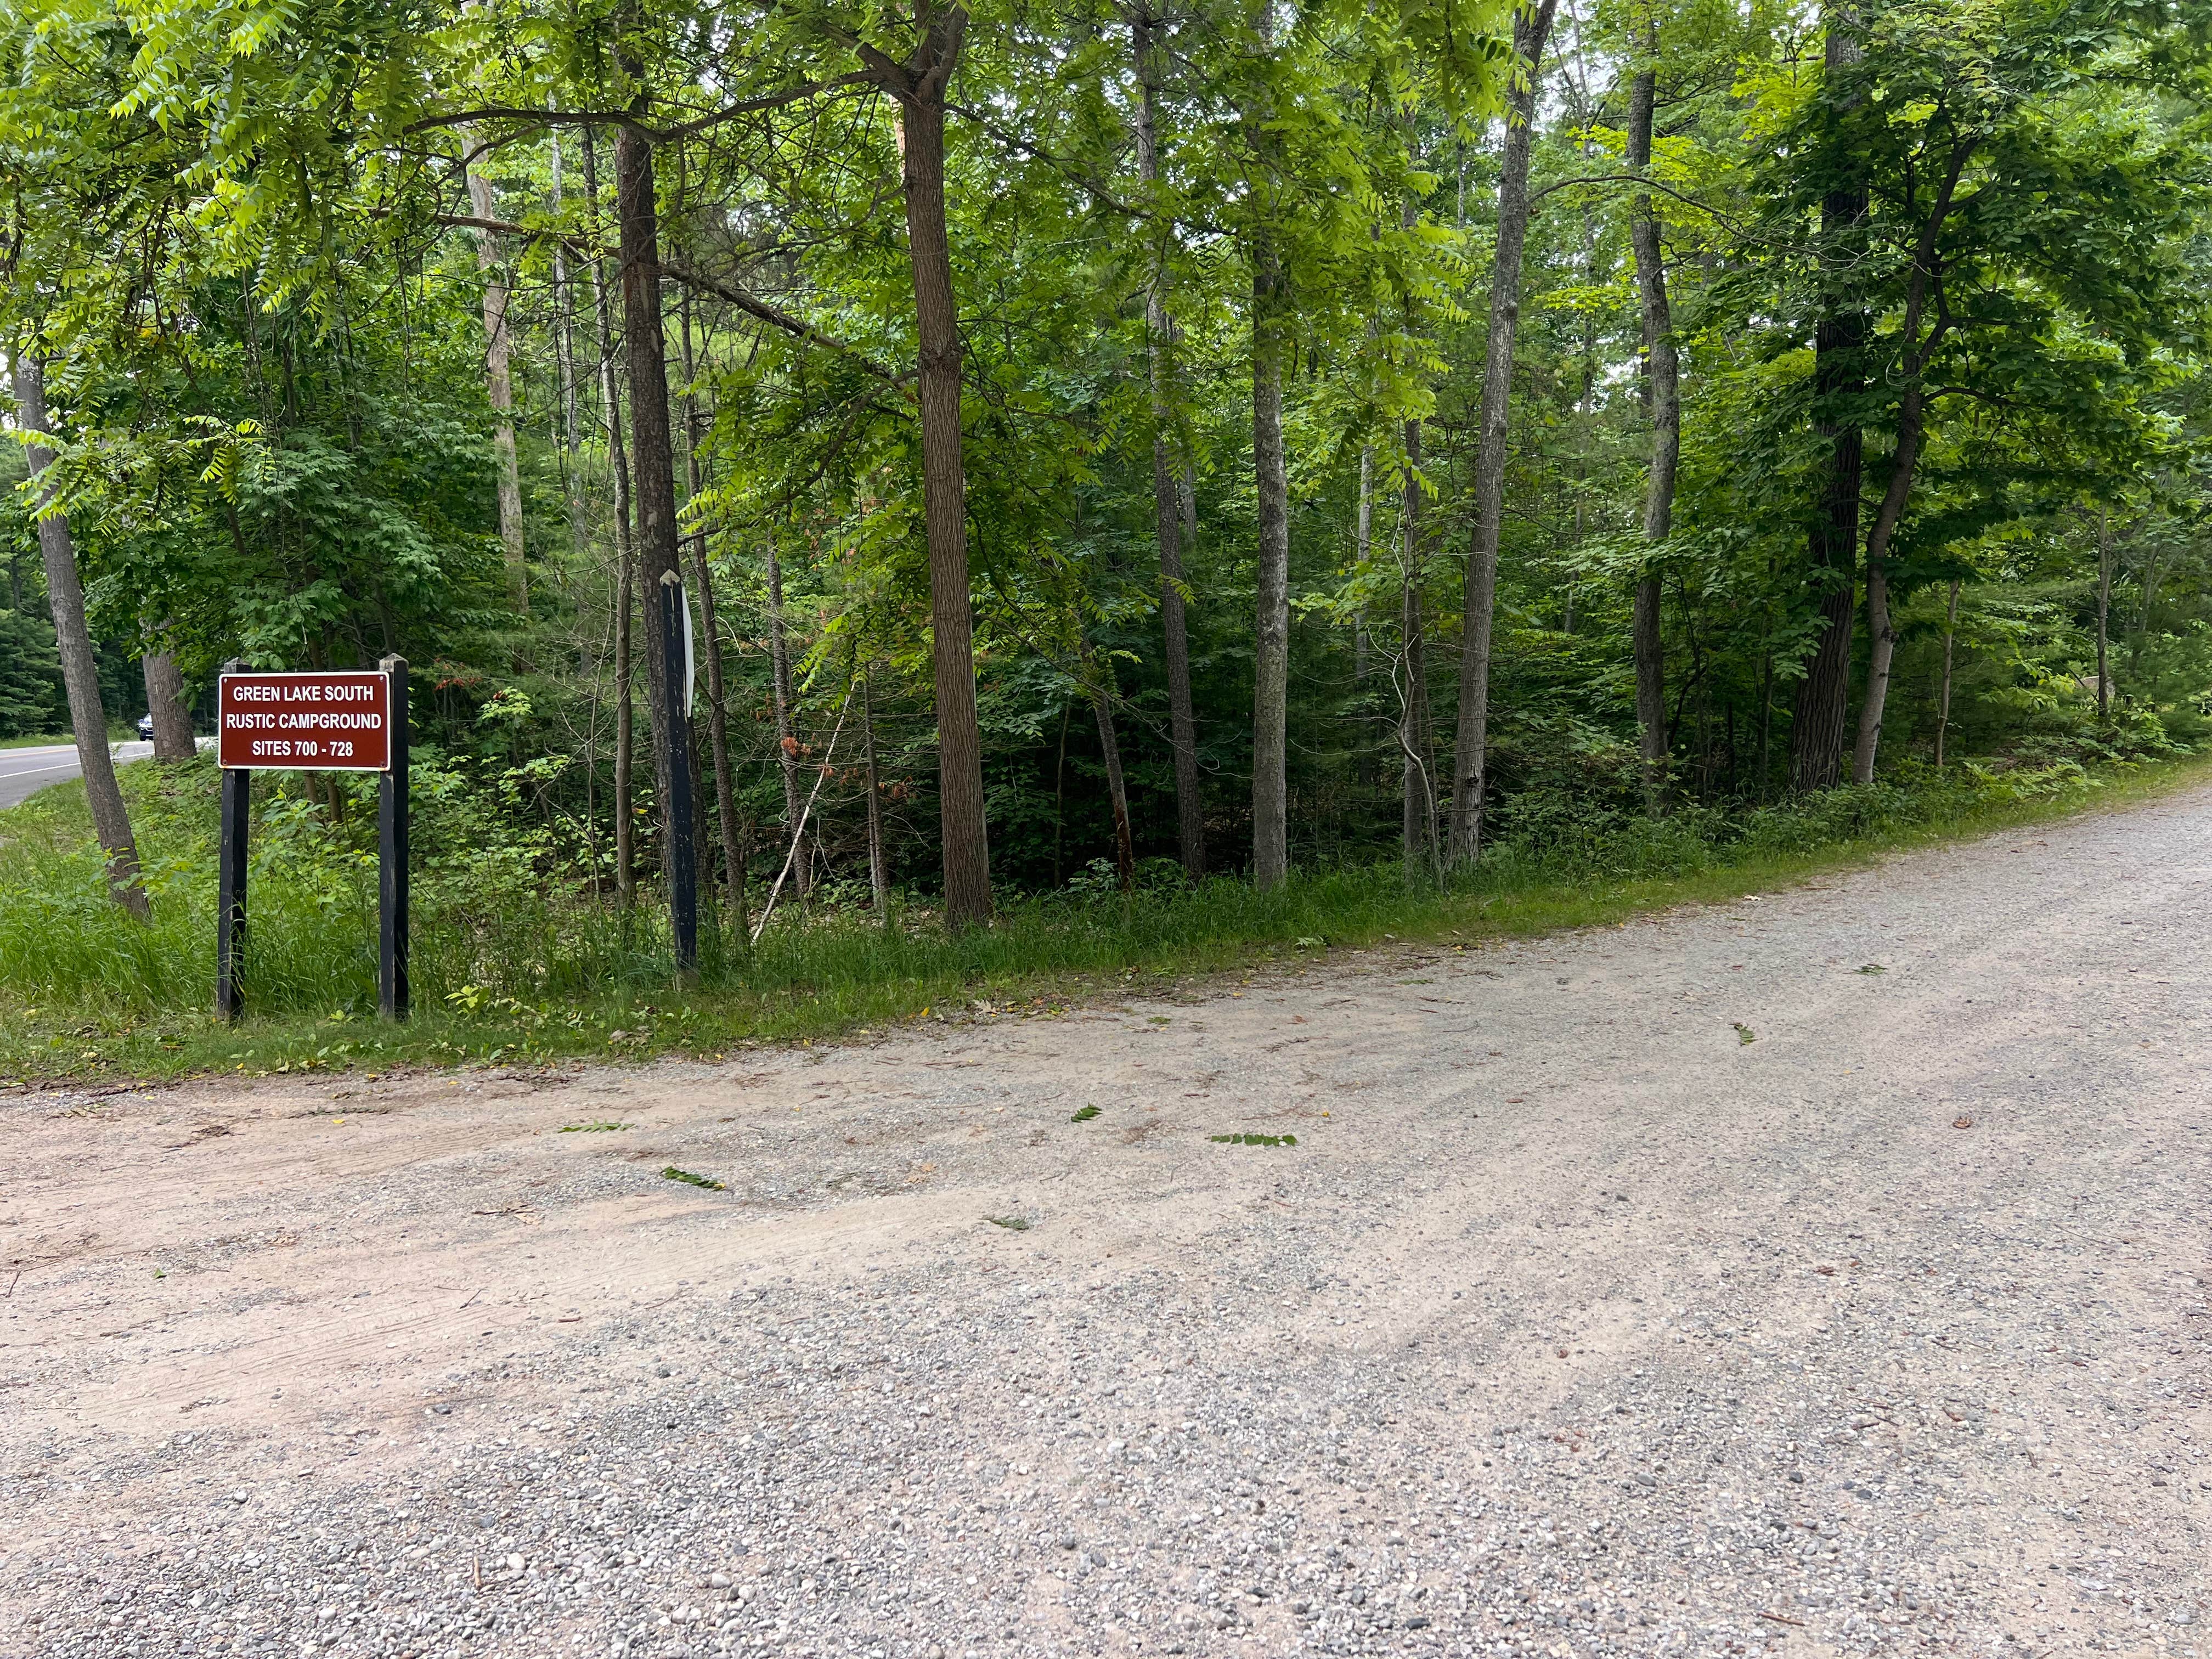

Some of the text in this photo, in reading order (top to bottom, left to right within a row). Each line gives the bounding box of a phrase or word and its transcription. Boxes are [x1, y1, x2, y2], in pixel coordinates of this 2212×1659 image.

[233, 685, 374, 702] GREEN LAKE SOUTH
[227, 713, 381, 729] RUSTIC CAMPGROUND
[252, 740, 291, 756] SITES
[295, 741, 318, 756] 700
[329, 741, 353, 757] 728
